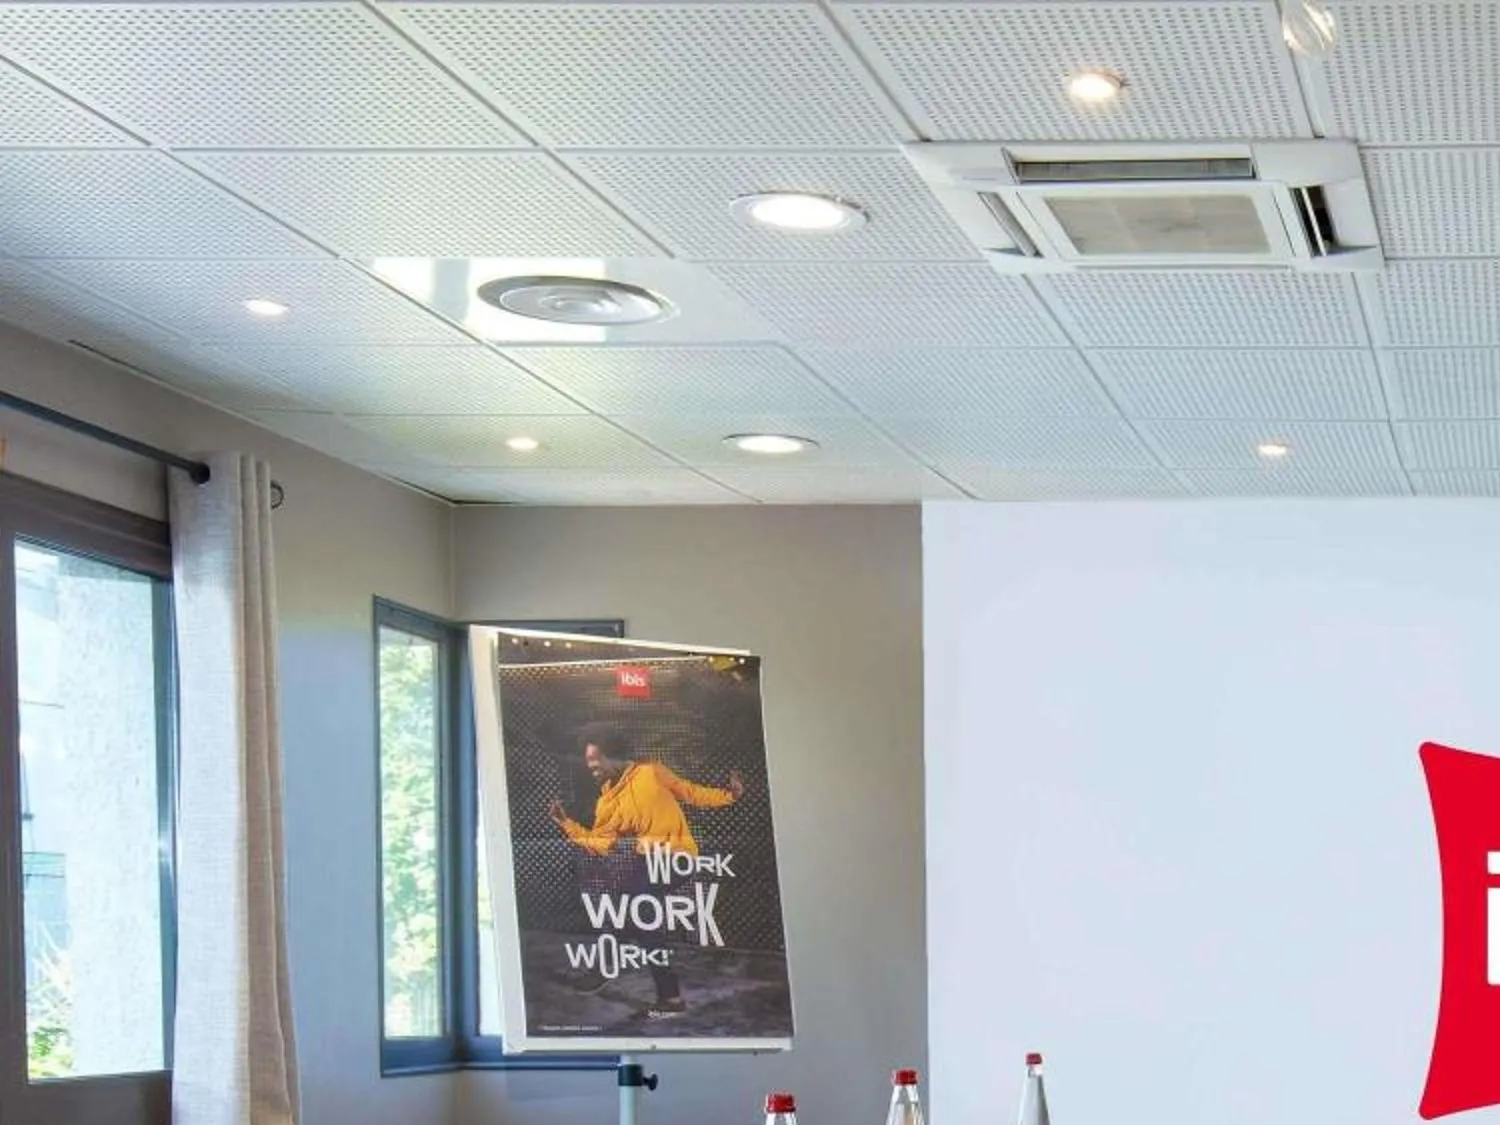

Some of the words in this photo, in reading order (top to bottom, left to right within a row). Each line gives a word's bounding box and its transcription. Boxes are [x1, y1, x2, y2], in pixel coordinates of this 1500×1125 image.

[621, 670, 646, 687] ibis
[643, 841, 736, 885] WORK
[581, 881, 726, 948] WORK
